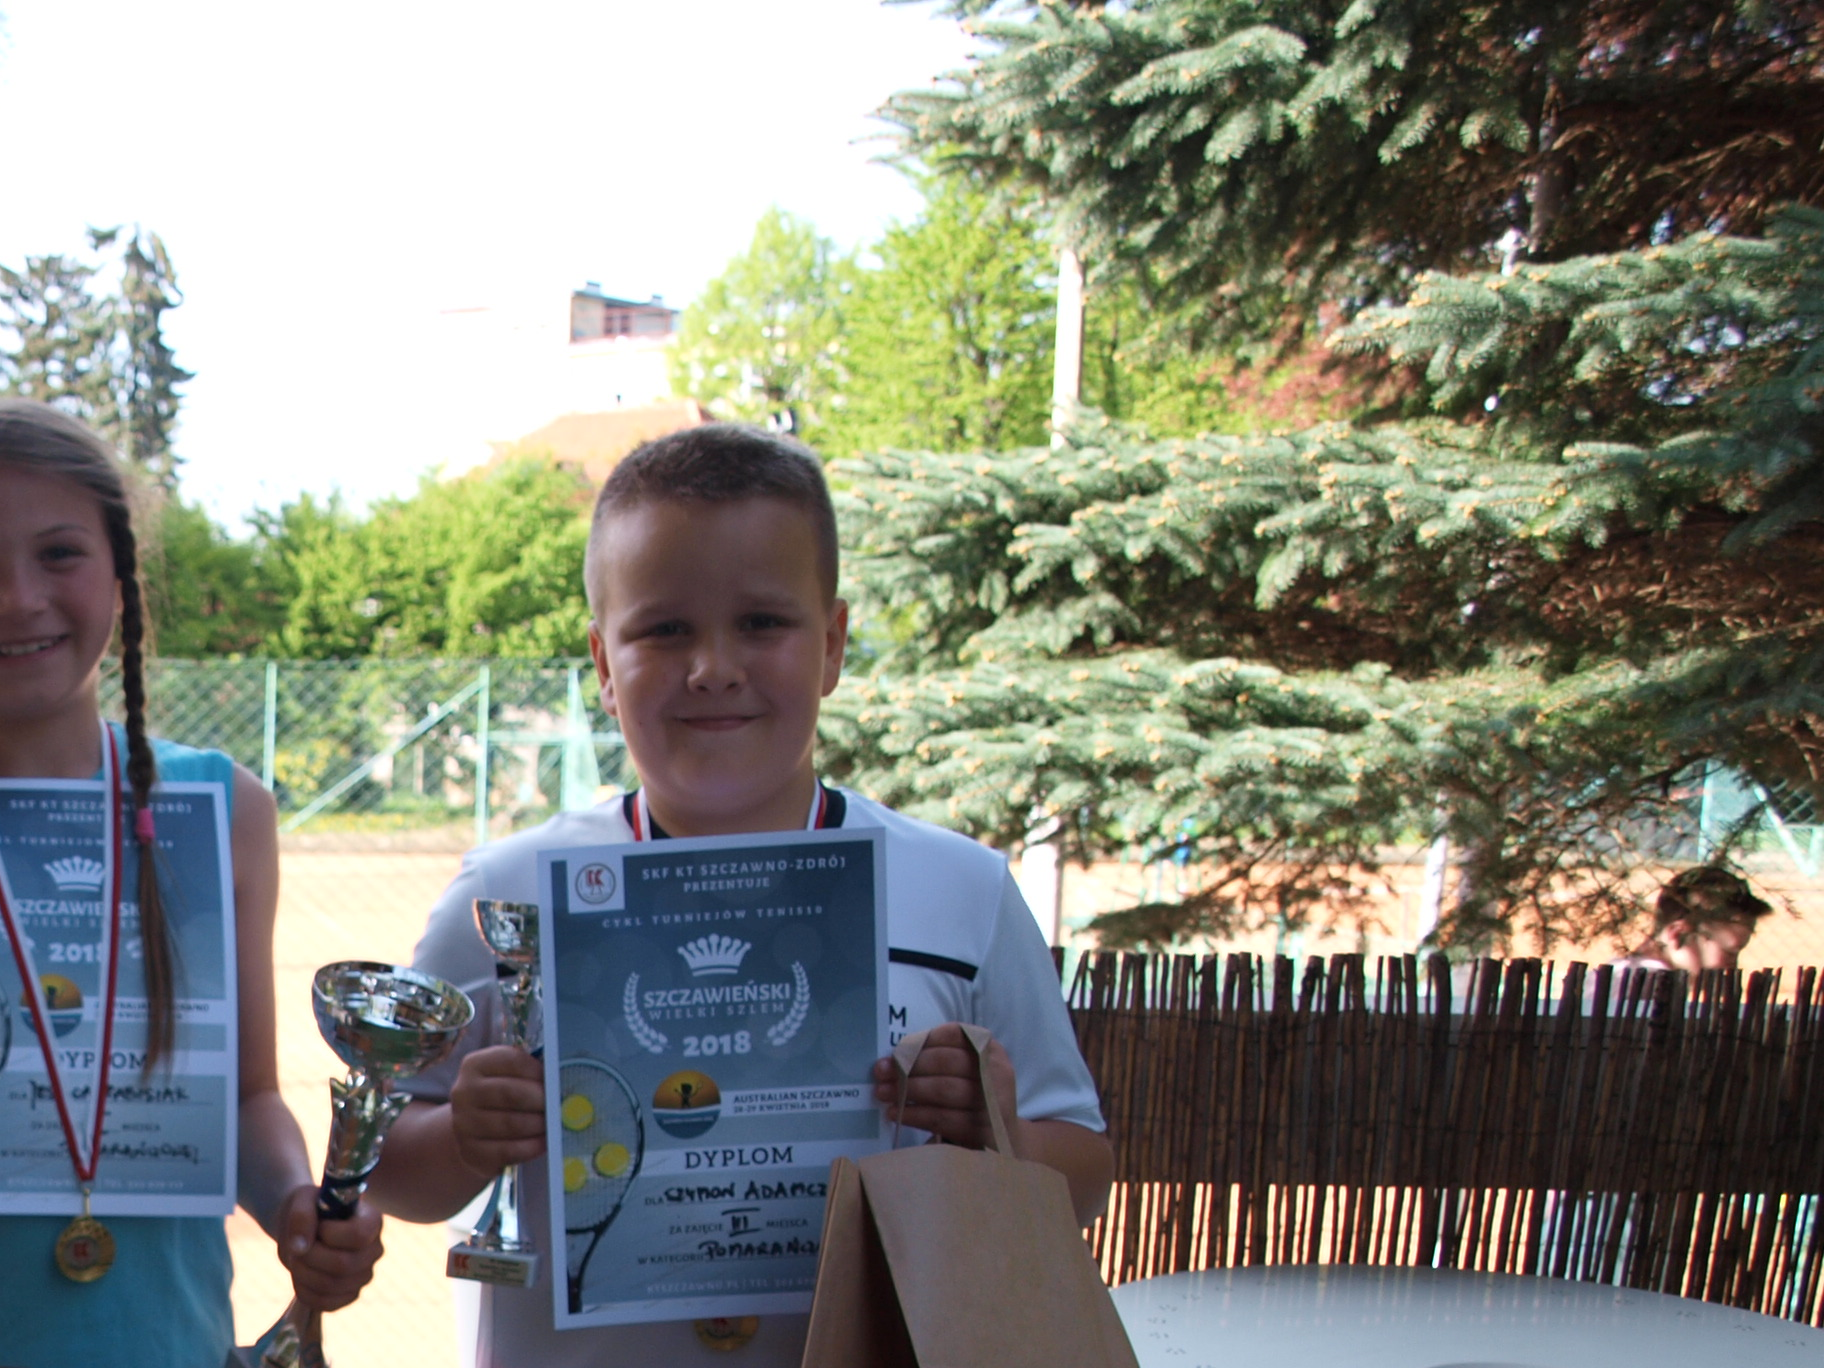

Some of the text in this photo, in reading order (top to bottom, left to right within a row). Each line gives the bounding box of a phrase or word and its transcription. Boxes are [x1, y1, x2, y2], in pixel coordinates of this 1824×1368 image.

[642, 866, 670, 880] SKF
[675, 865, 695, 878] KT
[683, 877, 771, 893] PREZENTUJE
[644, 979, 792, 1009] SZCZAWIEŃSKI
[648, 1005, 717, 1022] WIELKI
[682, 1030, 753, 1058] 2018
[733, 1088, 861, 1104] AUSTRALIAN SZCZAWNO
[685, 1146, 794, 1169] DYPLOM
[744, 1178, 829, 1200] ADAMCZ
